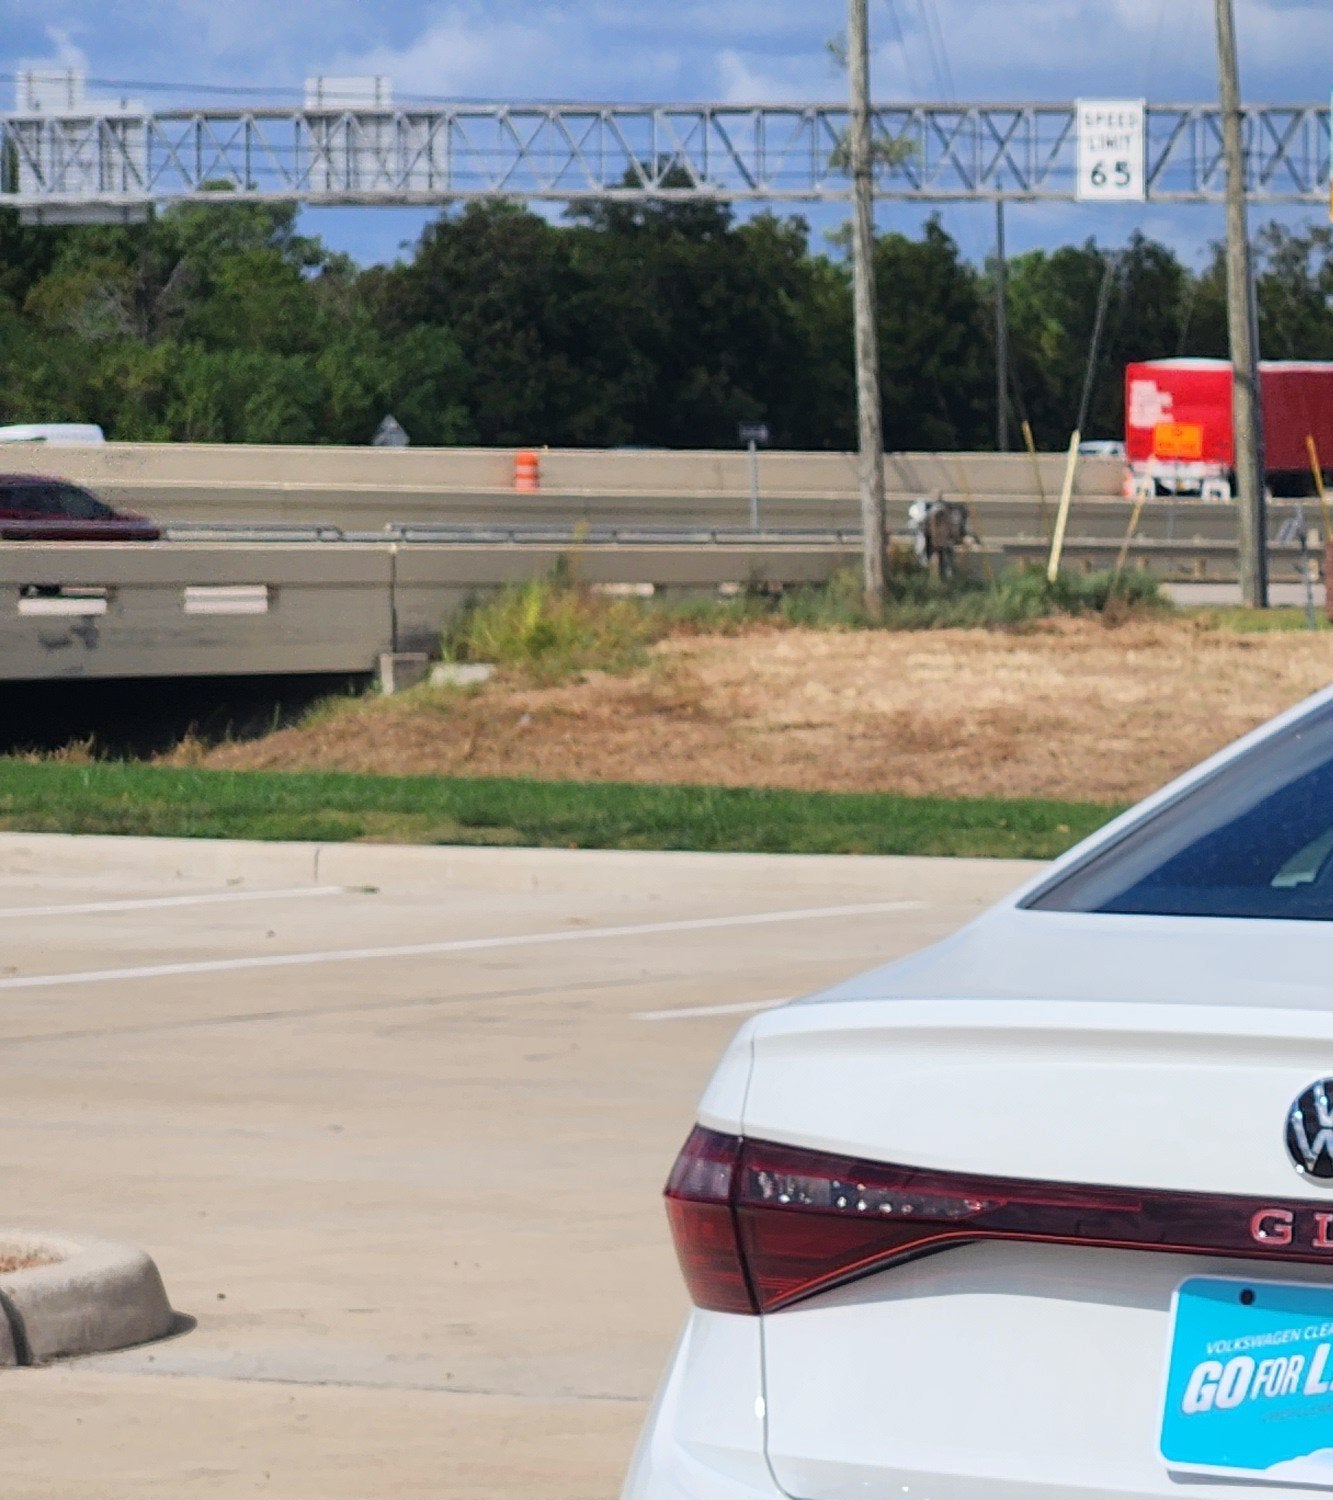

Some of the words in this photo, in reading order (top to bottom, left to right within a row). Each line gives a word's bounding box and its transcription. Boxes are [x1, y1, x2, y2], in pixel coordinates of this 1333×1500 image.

[1085, 111, 1138, 127] SPEED
[1089, 134, 1131, 151] LIMIT
[1090, 160, 1131, 187] 65
[1205, 1328, 1301, 1355] VOLKSWAGEN
[1181, 1355, 1256, 1415] GO
[1249, 1354, 1306, 1402] FOR
